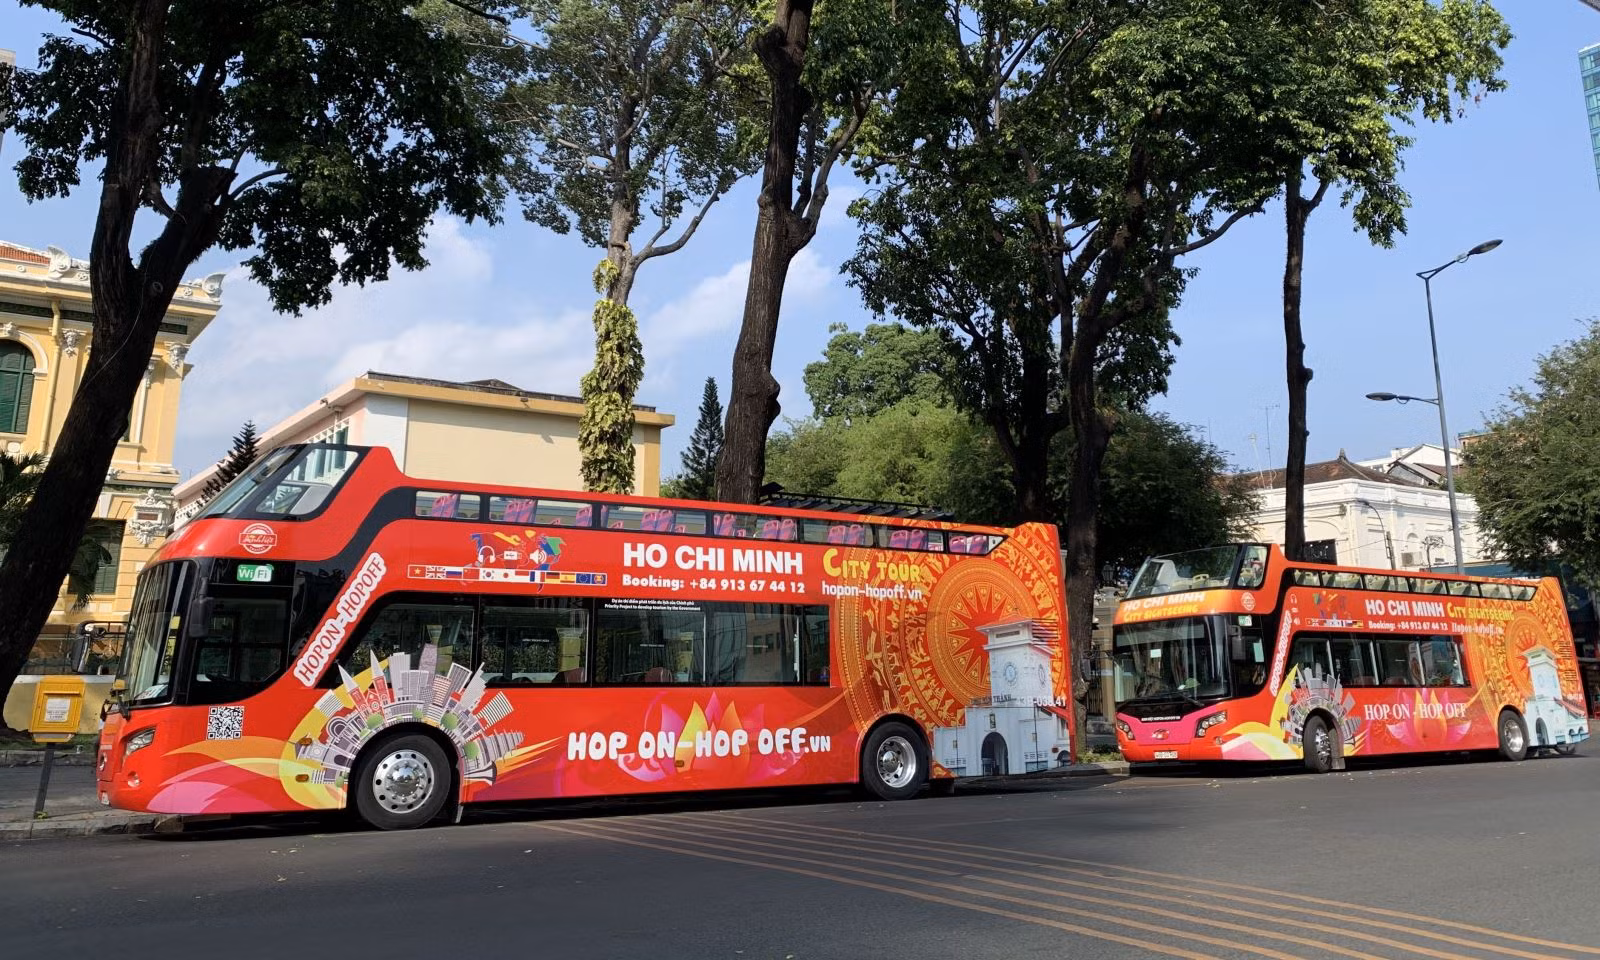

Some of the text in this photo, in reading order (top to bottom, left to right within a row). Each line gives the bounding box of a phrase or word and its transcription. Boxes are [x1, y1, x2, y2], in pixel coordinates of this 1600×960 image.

[624, 542, 803, 575] HO CHI MINH
[622, 574, 805, 593] Booking: +84 913 67 44 12
[822, 580, 922, 601] hopon-hopoff.vn
[1144, 596, 1164, 609] CHI
[1168, 592, 1205, 604] MINH
[1365, 599, 1385, 615] HO
[1387, 600, 1410, 616] CHI
[1412, 601, 1445, 617] MINH
[568, 731, 627, 761] HOP
